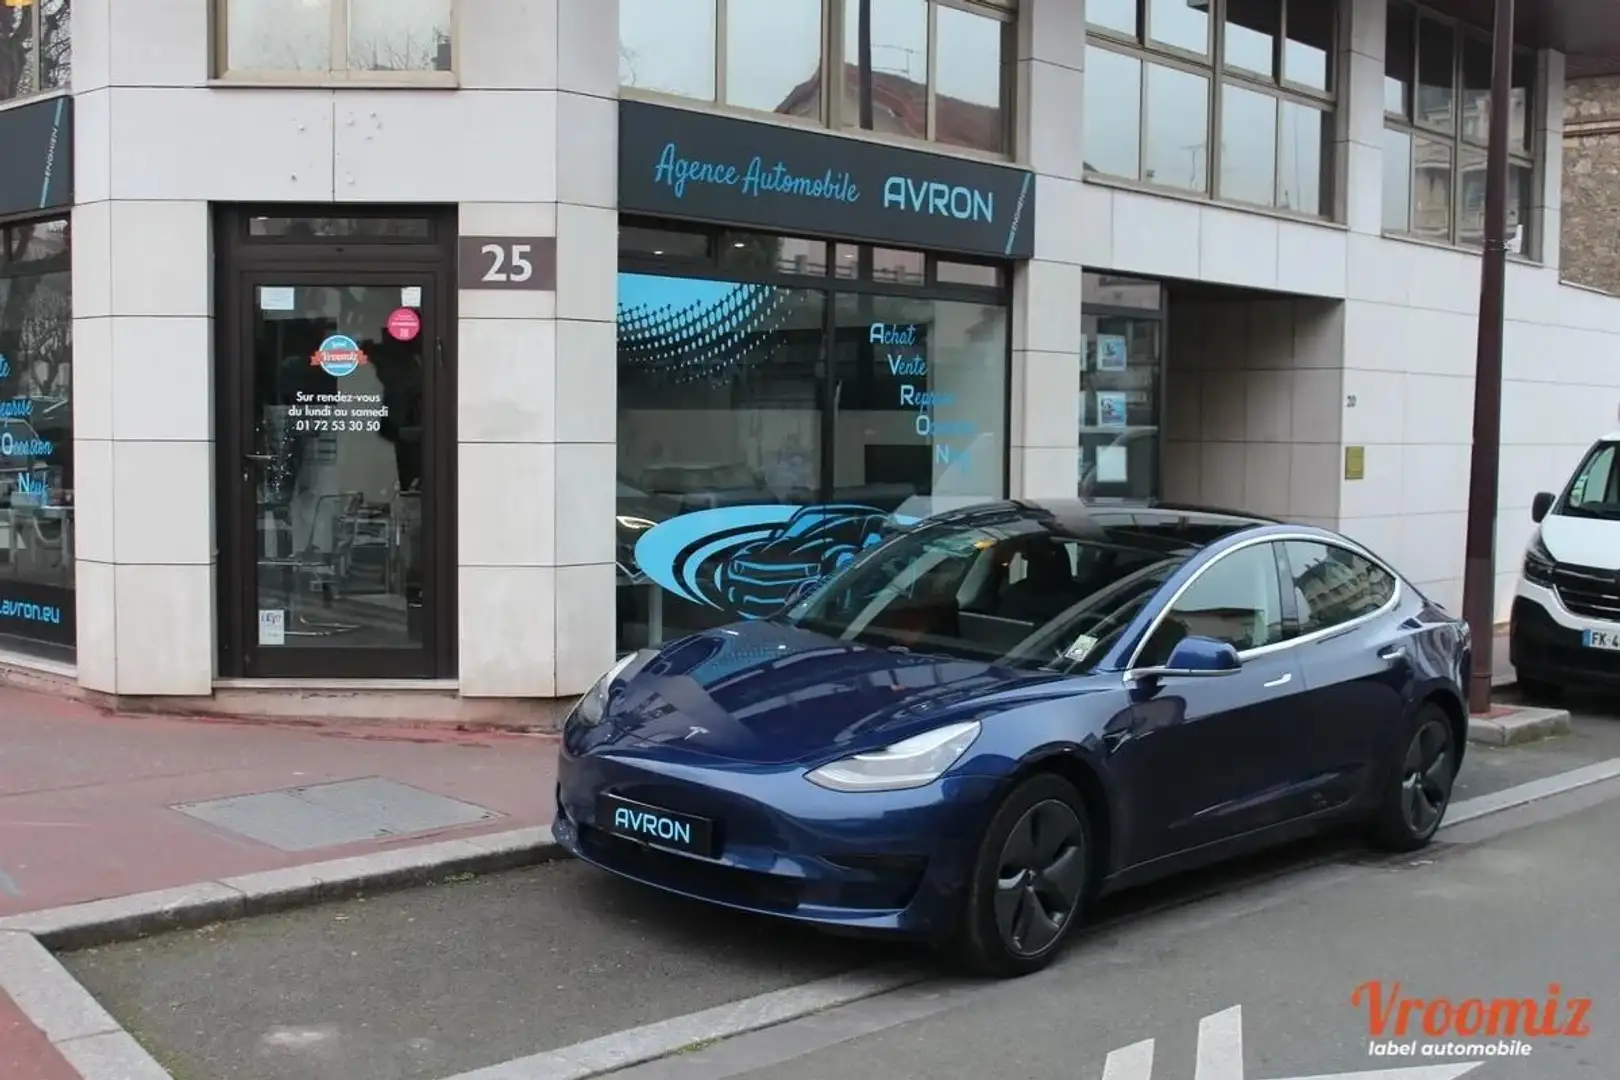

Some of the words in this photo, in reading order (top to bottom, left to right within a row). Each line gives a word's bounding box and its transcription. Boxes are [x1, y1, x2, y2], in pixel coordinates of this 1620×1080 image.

[654, 143, 740, 198] Agence
[742, 156, 861, 202] Automobile
[883, 176, 993, 223] AVRON
[481, 244, 532, 282] 25
[870, 322, 916, 346] Achat
[887, 353, 928, 376] Vente
[296, 391, 314, 402] Sur
[316, 391, 381, 402] rendez-vous
[288, 405, 302, 417] du
[305, 405, 331, 417] lundi
[334, 407, 348, 417] au
[351, 405, 389, 417] samedi
[296, 420, 310, 431] 01
[313, 420, 328, 431] 72
[331, 420, 346, 431] 53
[349, 420, 363, 431] 30
[366, 420, 381, 431] 50
[615, 807, 690, 844] AVRON
